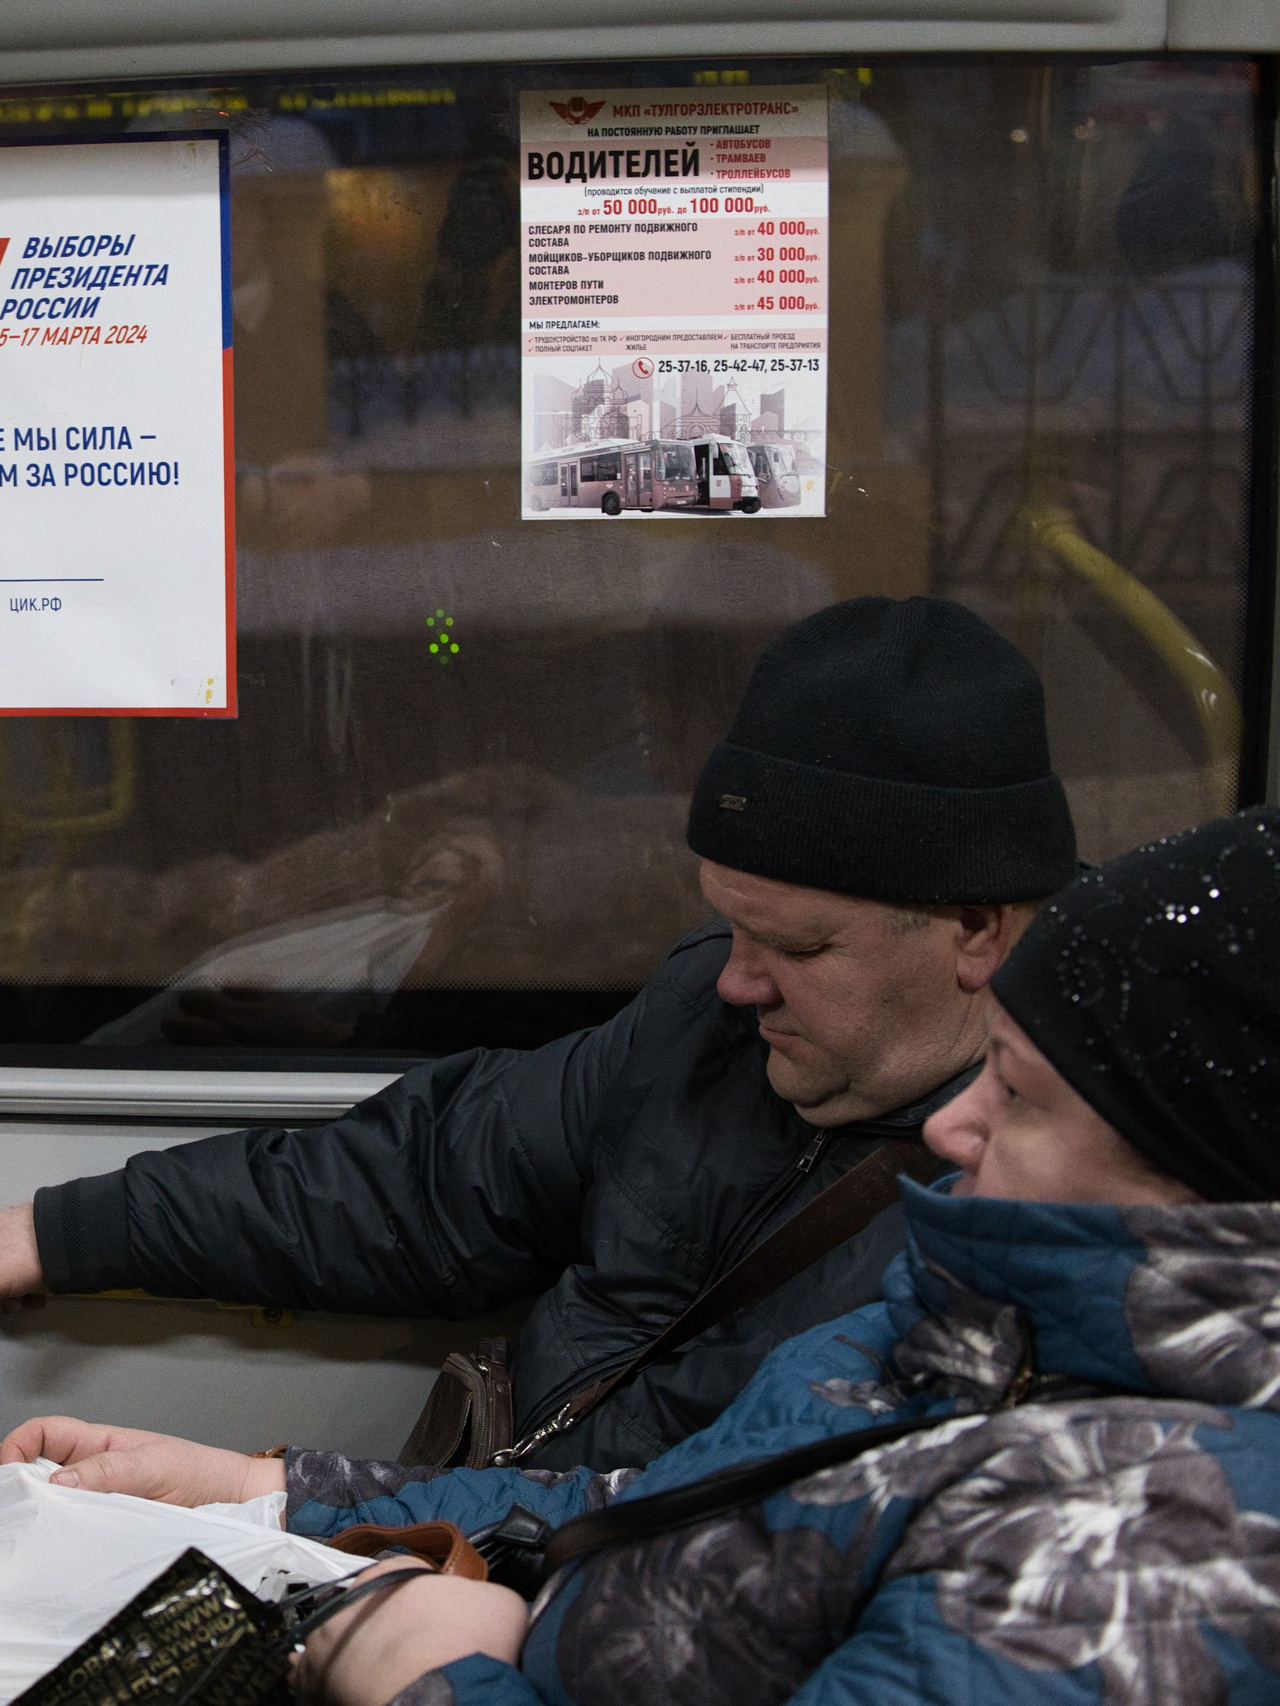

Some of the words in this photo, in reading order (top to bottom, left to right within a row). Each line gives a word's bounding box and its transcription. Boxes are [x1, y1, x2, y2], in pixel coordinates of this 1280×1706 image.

[613, 105, 640, 118] МКП
[644, 102, 798, 117] «ТУЛГОРЭЛЕКТРОТРАНС»
[587, 127, 599, 137] НА
[602, 126, 662, 137] ПОСТОЯННУЮ
[664, 126, 698, 136] РАБОТУ
[700, 125, 760, 135] ПРИГЛАШАЕТ
[716, 139, 771, 149] АВТОБУСОВ
[528, 141, 700, 183] ВОДИТЕЛЕЙ
[716, 153, 766, 163] ТРАМВАЕВ
[716, 168, 791, 179] ТРОЛЛЕЙБУСОВ
[584, 186, 632, 197] (проводится
[634, 186, 671, 196] обучение
[680, 184, 718, 195] выплатой
[719, 183, 764, 195] стипендии)
[603, 200, 622, 216] 50
[677, 207, 687, 215] до
[690, 198, 720, 214] 100
[528, 224, 570, 235] СЛЕСАРЯ
[574, 224, 586, 234] ПО
[589, 223, 631, 234] РЕМОНТУ
[634, 222, 698, 233] ПОДВИЖНОГО
[757, 222, 775, 236] 40
[22, 234, 135, 259] ВЫБОРЫ
[529, 238, 569, 248] СОСТАВА
[648, 250, 712, 261] ПОДВИЖНОГО
[757, 248, 775, 262] 30
[529, 266, 569, 276] СОСТАВА
[757, 271, 775, 284] 40
[10, 264, 168, 292] ПРЕЗИДЕНТА
[529, 280, 578, 291] МОНТЕРОВ
[580, 280, 604, 290] ПУТИ
[529, 295, 619, 306] ЭЛЕКТРОМОНТЕРОВ
[757, 297, 775, 311] 45
[0, 296, 100, 321] РОССИИ
[529, 321, 543, 330] МЫ
[545, 319, 601, 330] ПРЕДЛАГАЕМ:
[42, 326, 101, 347] МАРТА
[103, 324, 148, 346] 2024
[535, 335, 589, 344] ТРУДОУСТРОЙСТВО
[672, 333, 723, 341] ПРЕДОСТАВЛЯЕМ
[730, 332, 770, 340] БЕСПЛАТНЫЙ
[772, 332, 795, 341] ПРОЕЗД
[563, 344, 593, 353] СОЦПАКЕТ
[626, 343, 647, 351] ЖИЛЬЕ
[779, 342, 821, 350] ПРЕДПРИЯТИЯ
[658, 360, 711, 375] 25-37-16,
[714, 359, 768, 374] 25-42-47,
[770, 359, 819, 372] 25-37-13
[14, 427, 58, 452] МЫ
[66, 426, 132, 451] СИЛА
[25, 463, 56, 488] ЗА
[64, 461, 180, 487] РОССИЮ!
[9, 597, 62, 615] ЦИК.РФ
